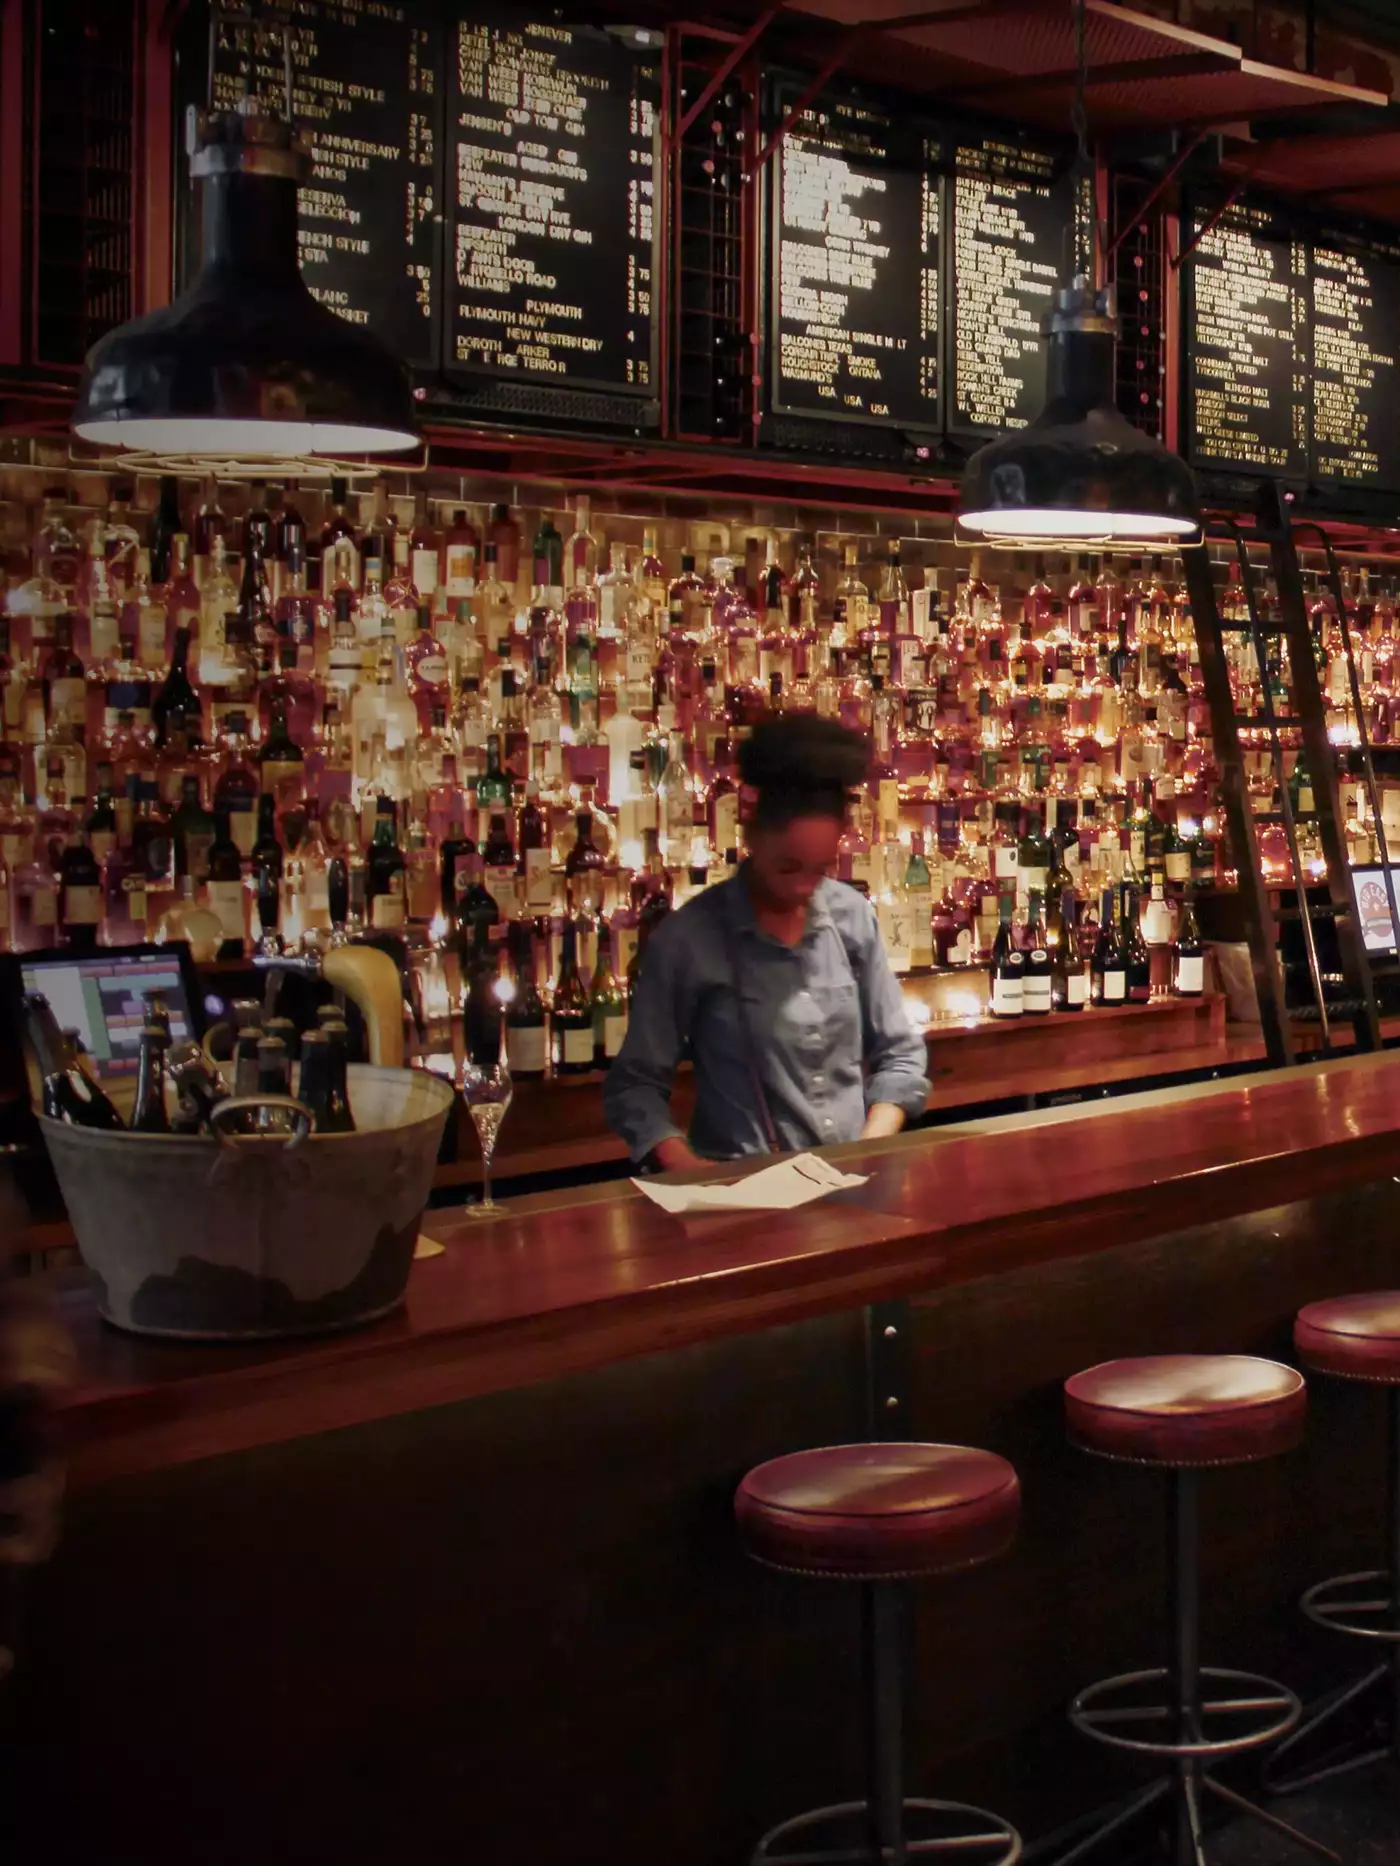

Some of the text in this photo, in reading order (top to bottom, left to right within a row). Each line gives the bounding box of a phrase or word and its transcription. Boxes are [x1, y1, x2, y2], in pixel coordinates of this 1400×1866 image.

[525, 23, 572, 44] JENEVER
[460, 58, 482, 72] VAN
[460, 70, 482, 84] VAN
[348, 84, 384, 103] STYLE
[460, 82, 482, 98] VAN
[534, 115, 558, 131] TOM
[565, 121, 586, 136] GIN
[320, 132, 400, 160] ANNIVERSARY
[336, 154, 370, 170] STYLE
[458, 143, 518, 168] BEEFEATER
[956, 176, 1017, 199] BUFFALO TRACE
[498, 216, 592, 244] LONDON DRY GIN
[336, 236, 370, 254] STYLE
[994, 244, 1017, 258] COCK
[504, 257, 535, 273] DOOR
[458, 274, 510, 293] WILLIAMS
[526, 299, 582, 320] PLYMOUTH
[519, 313, 546, 328] NAVY
[507, 326, 604, 352] NEW WESTERN DRY
[806, 324, 882, 345] AMERICAN SINGLE
[956, 330, 972, 342] OLD
[1264, 326, 1276, 338] POT
[1278, 328, 1294, 342] STILL
[458, 335, 550, 359] DOROTH ARKER
[782, 334, 852, 354] BALCONES TEXAS
[956, 340, 1020, 360] OLD GRAND DAD
[782, 356, 840, 374] ROUGHSTOCK
[848, 355, 876, 368] SMOKE
[984, 354, 1002, 366] YELL
[1253, 356, 1269, 366] MALT
[957, 370, 978, 382] ROCK
[980, 373, 996, 384] HILL
[818, 385, 890, 415] USA USA USA
[970, 392, 1002, 404] GEORGE
[994, 386, 1018, 398] CREEK
[1230, 394, 1252, 405] BLACK
[1252, 386, 1268, 397] MALT
